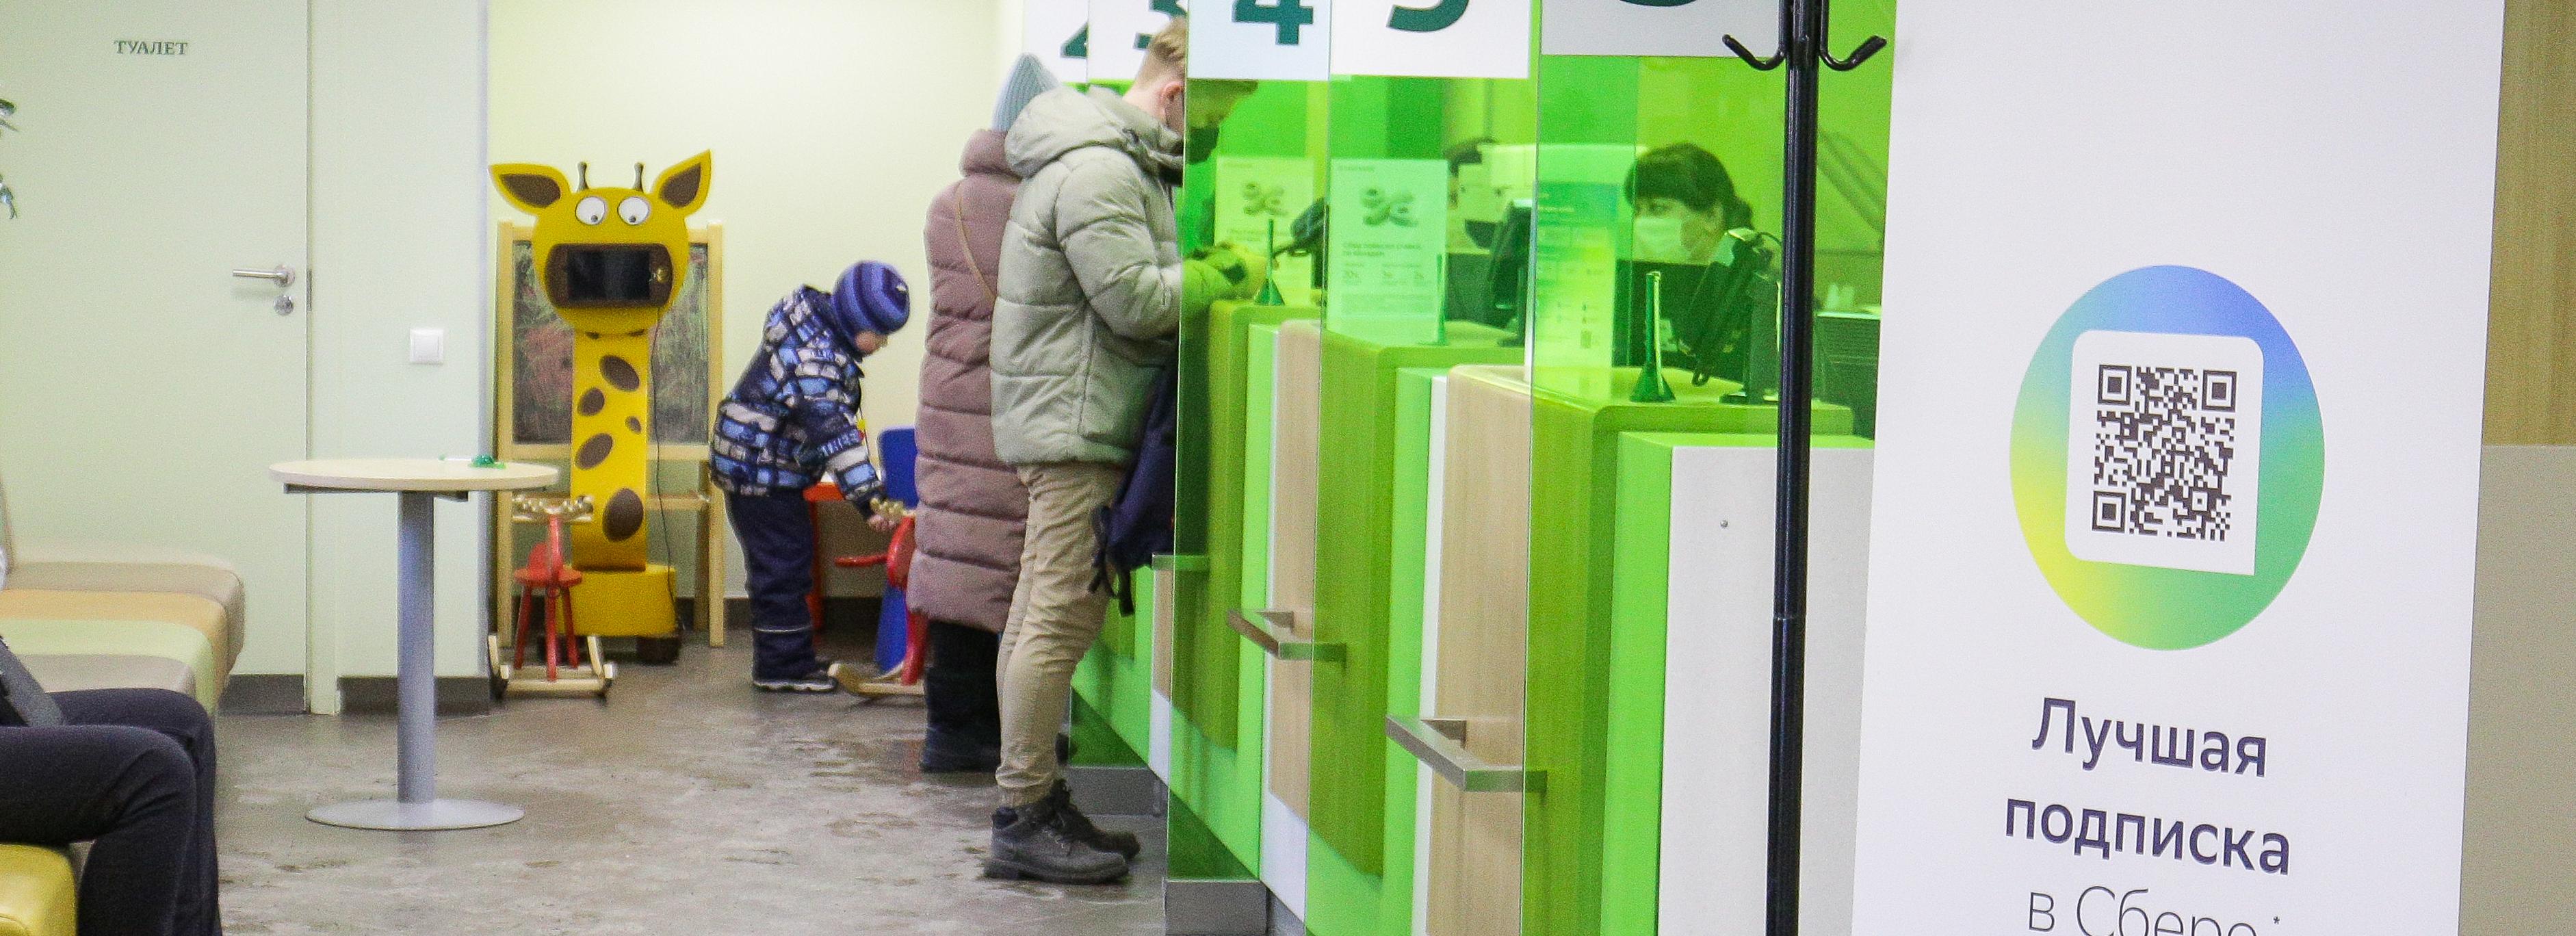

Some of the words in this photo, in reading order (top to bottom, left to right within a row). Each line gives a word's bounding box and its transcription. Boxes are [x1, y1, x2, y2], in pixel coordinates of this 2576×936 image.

[114, 40, 188, 55] ТУАЛЕТ
[2031, 697, 2267, 777] Лучшая
[2005, 798, 2290, 875] подписка
[2028, 892, 2056, 933] в
